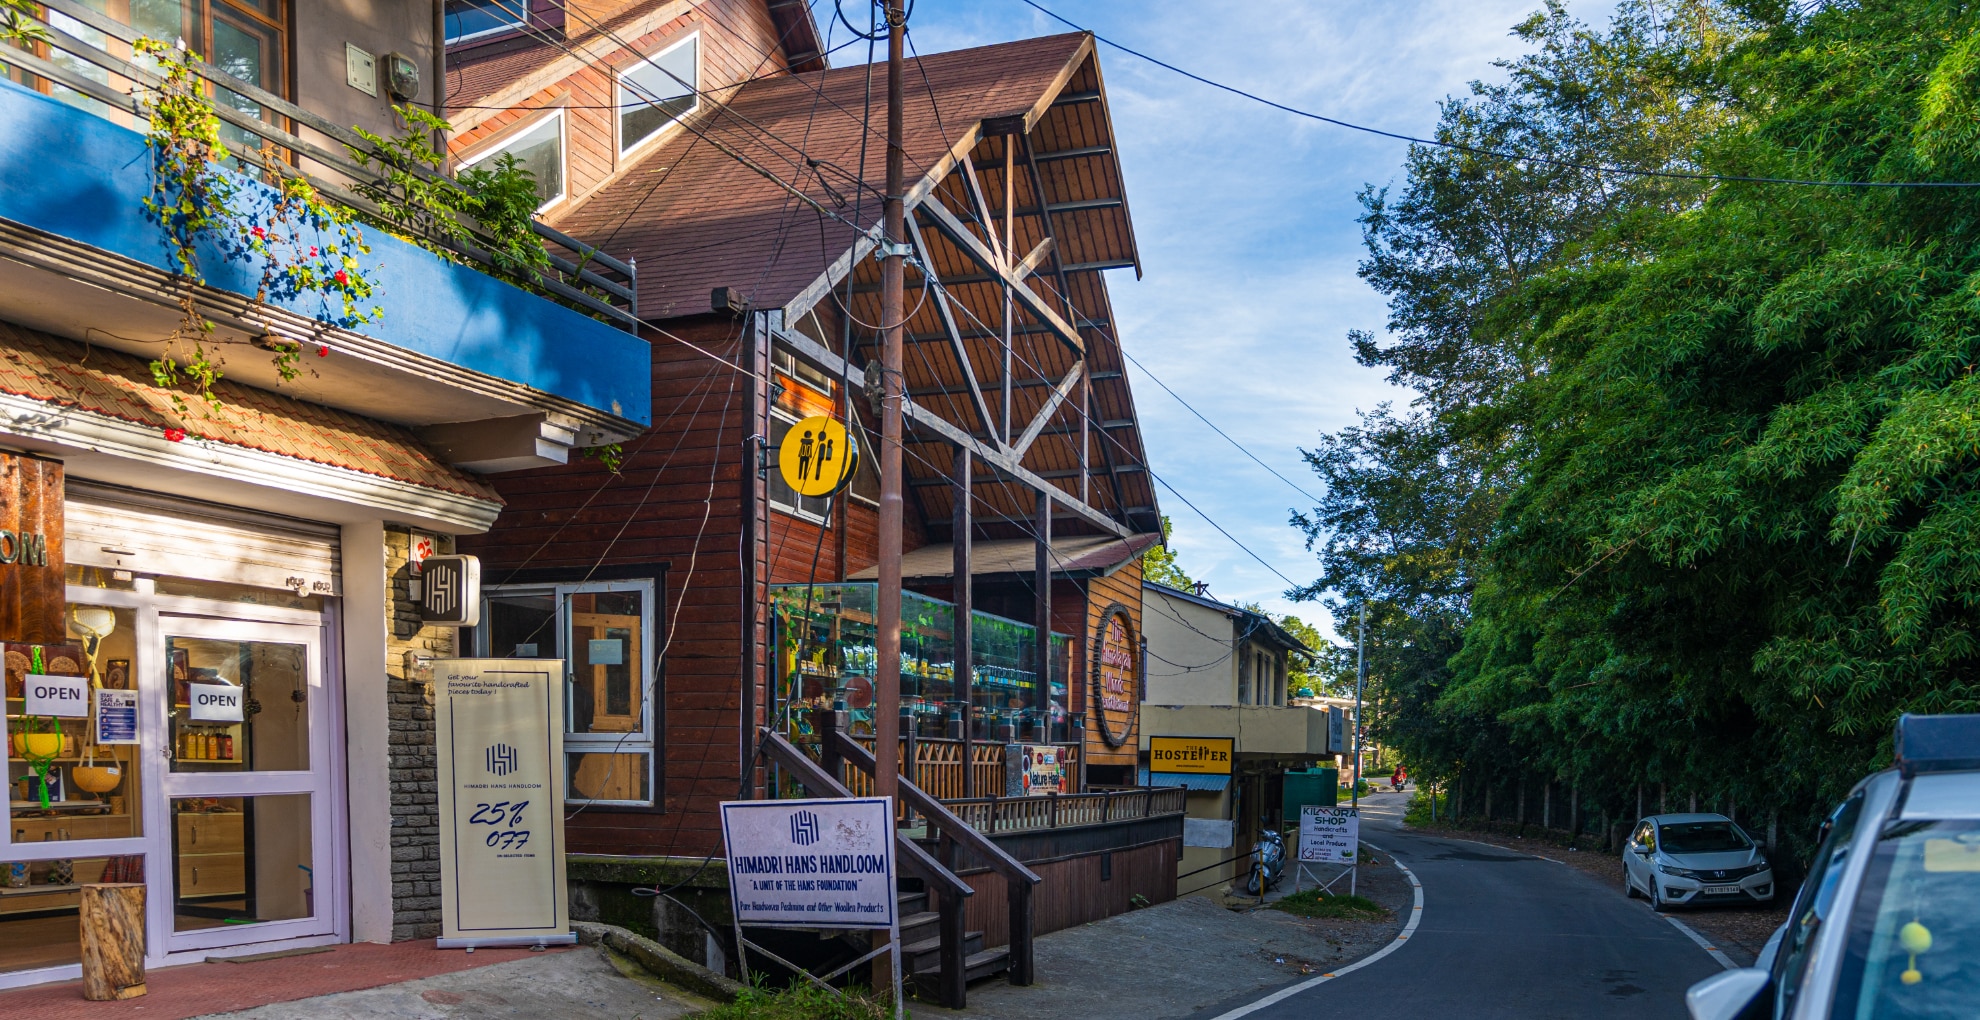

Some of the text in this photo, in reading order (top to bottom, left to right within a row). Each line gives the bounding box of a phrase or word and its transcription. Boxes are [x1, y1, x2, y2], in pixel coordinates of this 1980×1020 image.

[34, 685, 81, 701] OPEN
[447, 688, 470, 696] pieces
[470, 688, 493, 696] today
[198, 693, 237, 707] OPEN
[1030, 771, 1047, 786] Nature
[469, 800, 529, 827] 25%
[1315, 817, 1347, 825] SHOP
[1314, 825, 1347, 833] Handicrafts
[735, 855, 884, 874] HIMADRI HANS HANDLOOM
[759, 880, 774, 891] UNIT
[775, 880, 783, 891] OF
[784, 880, 796, 891] THE
[797, 880, 815, 891] HANS
[740, 901, 884, 913] Pure Handwoven Pashmina and Other Woollen Products
